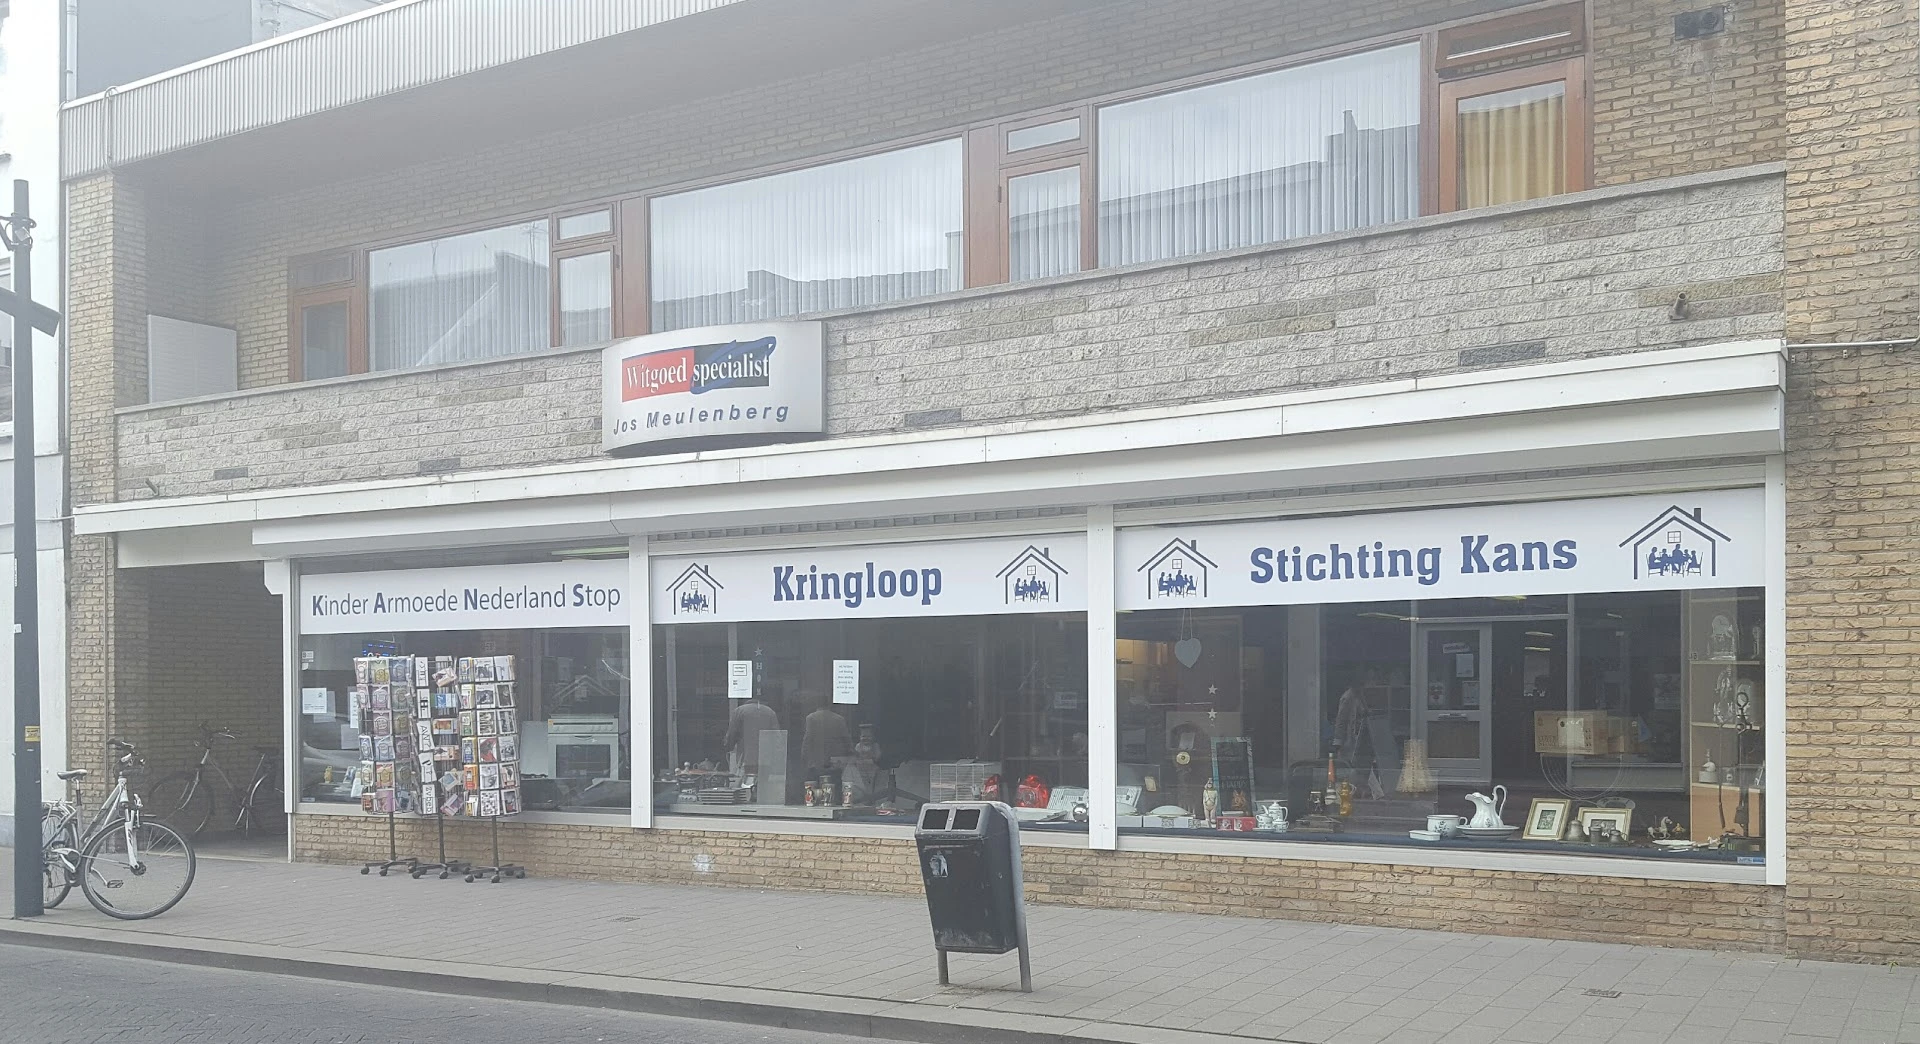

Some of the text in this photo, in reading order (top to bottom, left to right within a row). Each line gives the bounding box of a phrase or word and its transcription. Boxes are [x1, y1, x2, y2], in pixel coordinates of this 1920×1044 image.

[626, 352, 770, 393] Witgoed specialist
[613, 405, 789, 436] Jos Meulenberg
[1250, 534, 1578, 586] Stichting Kans
[312, 583, 621, 617] Kinder Armoede Nederland Stop
[773, 561, 942, 609] Kringloop
